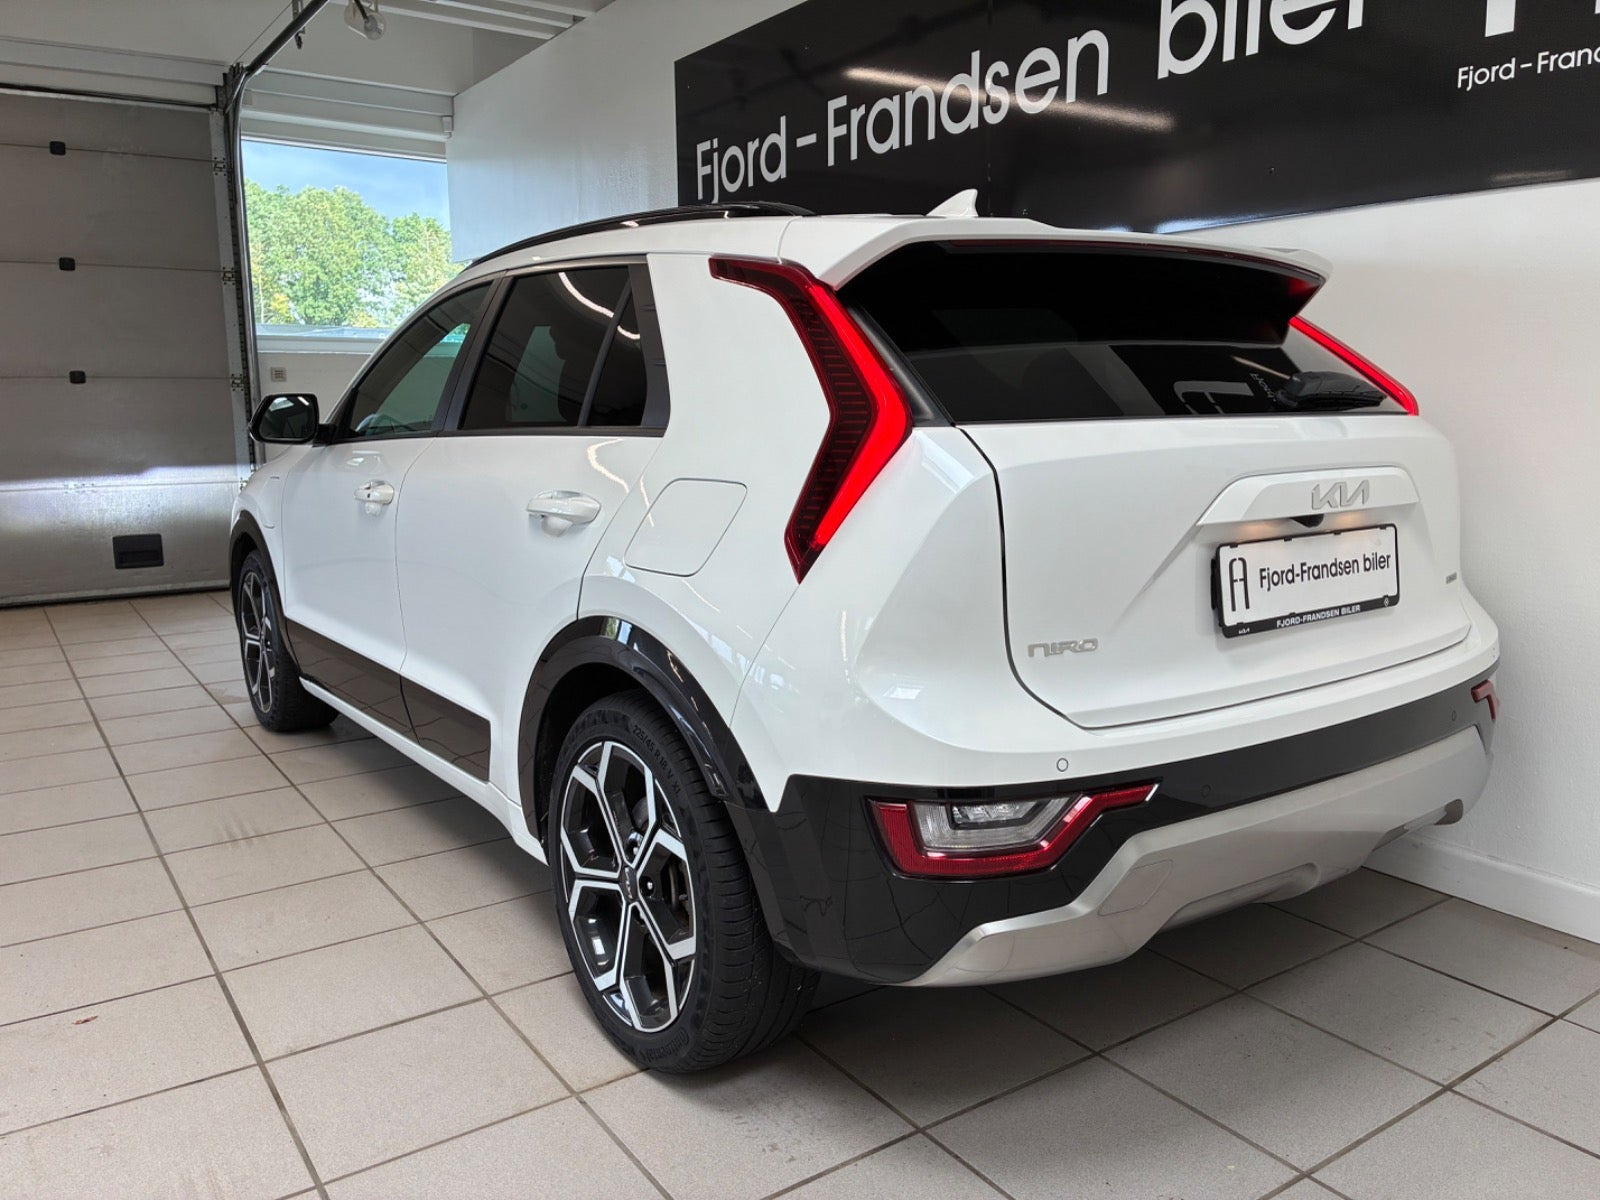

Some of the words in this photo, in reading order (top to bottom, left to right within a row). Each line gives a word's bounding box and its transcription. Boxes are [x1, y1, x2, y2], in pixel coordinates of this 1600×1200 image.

[827, 29, 1109, 167] Frandsen
[1259, 557, 1360, 591] Fjord-Frandsen
[1363, 552, 1391, 572] biler
[1276, 607, 1340, 628] FJORD-FRANDSEN
[1341, 604, 1361, 615] BILER
